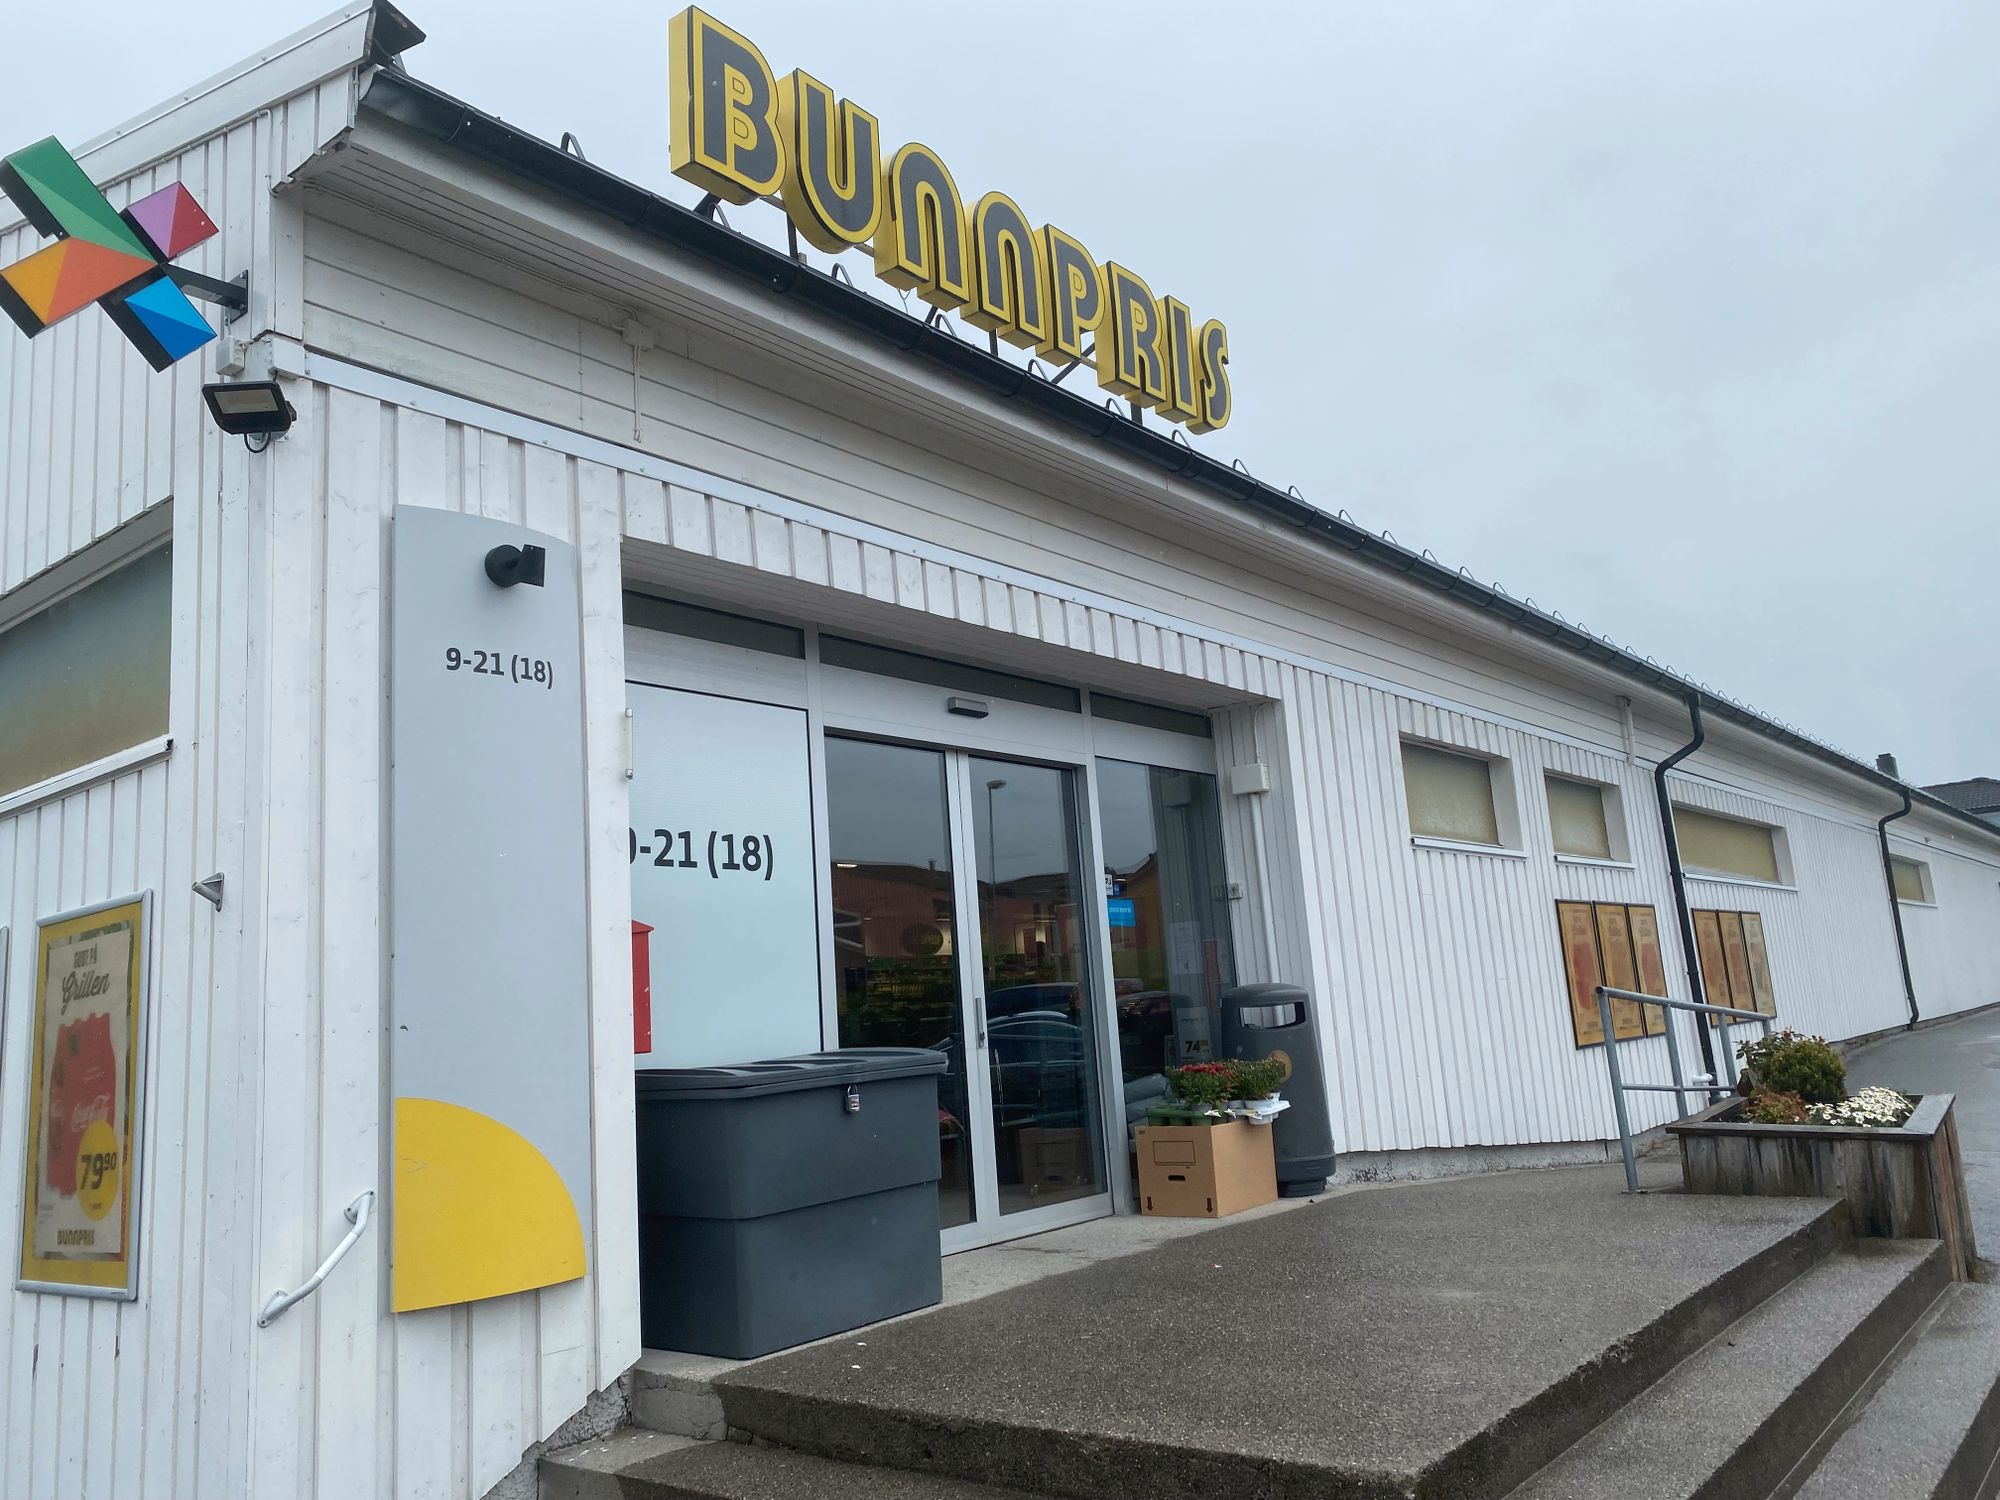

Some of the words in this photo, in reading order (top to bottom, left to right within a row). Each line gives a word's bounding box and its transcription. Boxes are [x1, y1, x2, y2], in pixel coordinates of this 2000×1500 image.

[670, 5, 1231, 434] BUNNPRIS
[445, 647, 505, 677] 9-21
[511, 654, 554, 690] (18)
[707, 830, 774, 881] (18)
[61, 970, 111, 1017] Grillen
